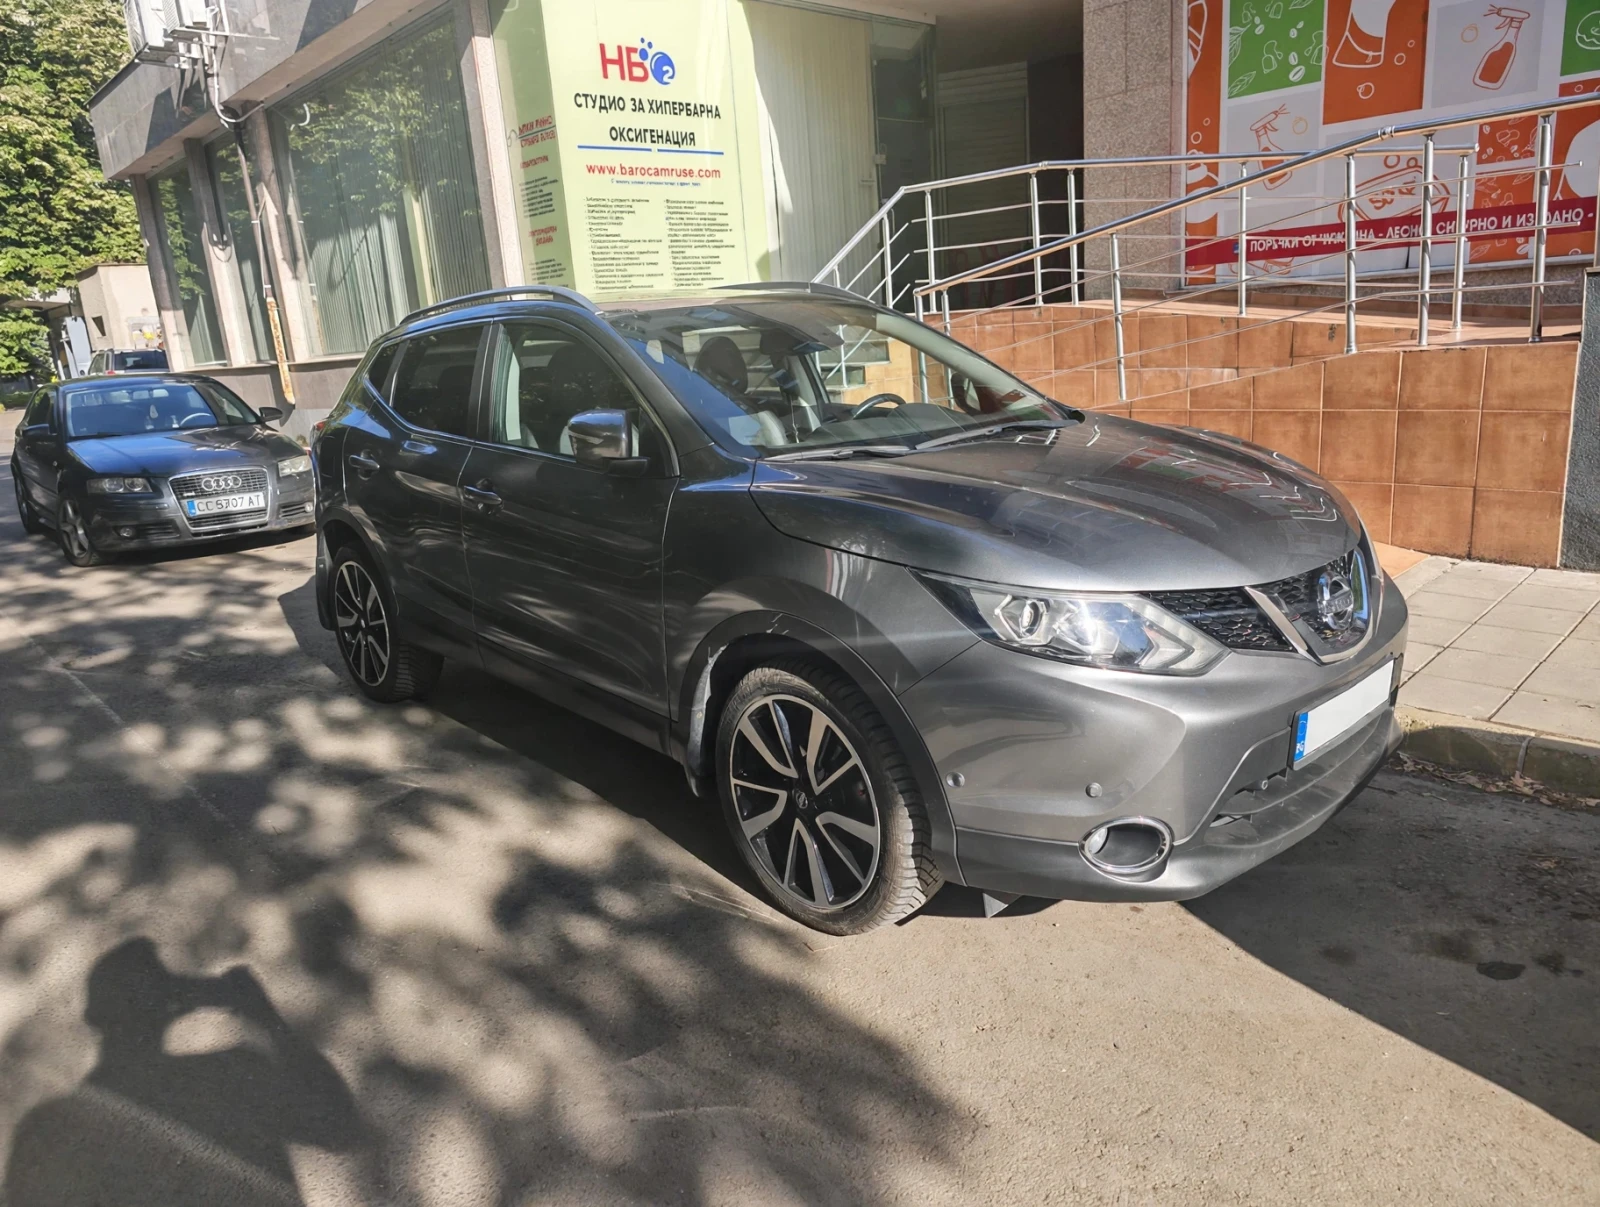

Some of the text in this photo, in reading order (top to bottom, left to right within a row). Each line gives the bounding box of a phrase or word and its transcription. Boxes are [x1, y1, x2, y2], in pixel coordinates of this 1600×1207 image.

[573, 92, 722, 119] СТУДИО ЗА ХИПЕРБАРНА
[609, 126, 696, 148] ОКСИГЕНАЦИЯ
[585, 163, 721, 178] www.barocamruse.com
[1302, 234, 1317, 247] ОТ
[1435, 216, 1498, 235] СИРНО
[1501, 215, 1512, 229] И
